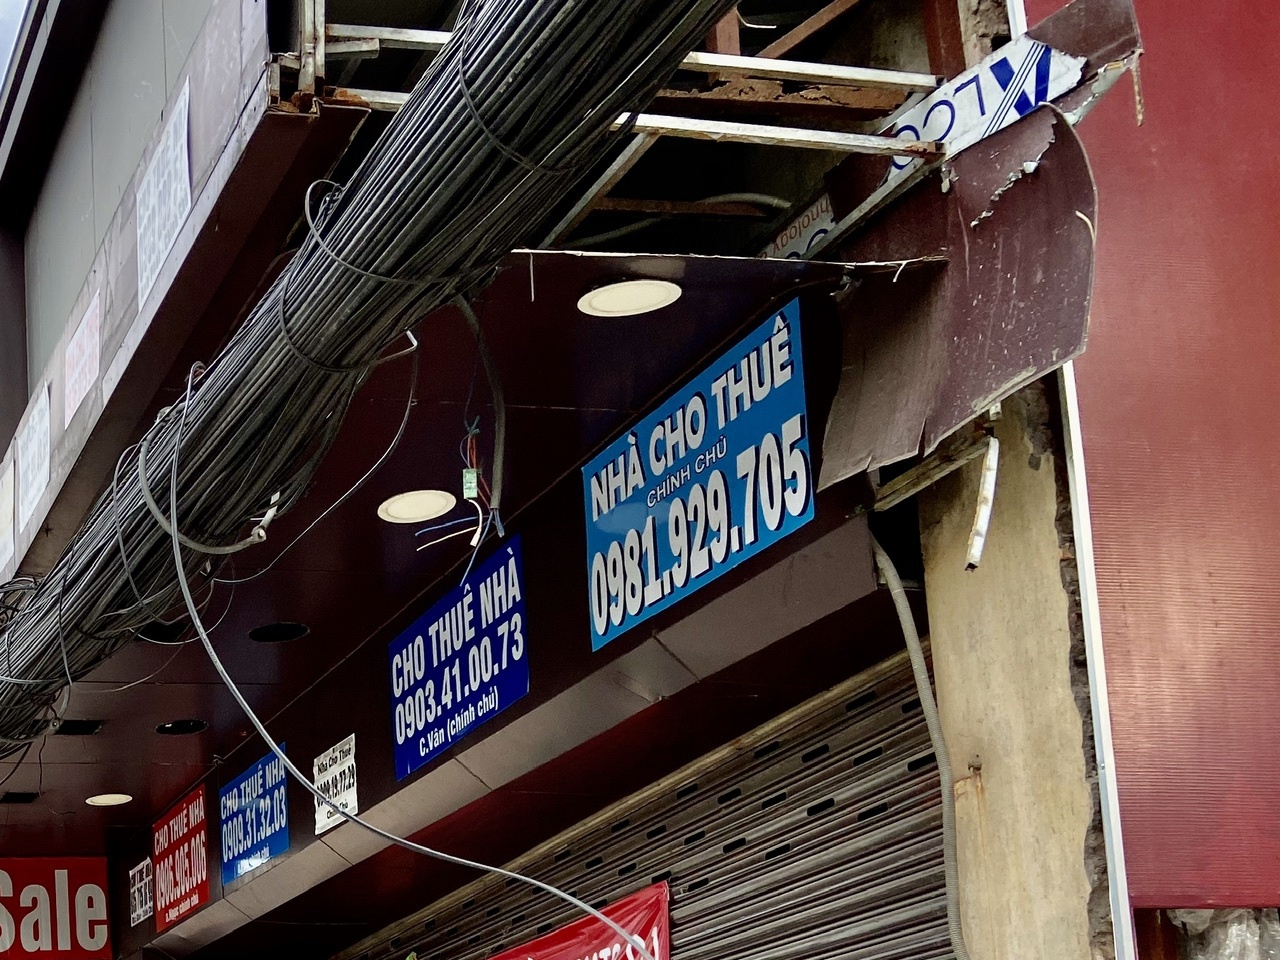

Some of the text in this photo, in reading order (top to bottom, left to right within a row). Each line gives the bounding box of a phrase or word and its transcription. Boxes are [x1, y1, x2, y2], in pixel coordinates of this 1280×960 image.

[591, 315, 793, 523] NHÀ CHO THUÊ
[646, 436, 728, 509] CHÍNH CHỦ
[591, 413, 808, 637] 0981.929.705
[392, 547, 521, 698] CHO THUÊ NHÀ
[395, 612, 525, 746] 0903.41.00.73
[154, 790, 205, 856] CHO THUÊ NHÀ
[221, 788, 238, 820] CHO
[240, 764, 264, 806] THUÊ
[222, 784, 287, 864] 0909.31.32.03
